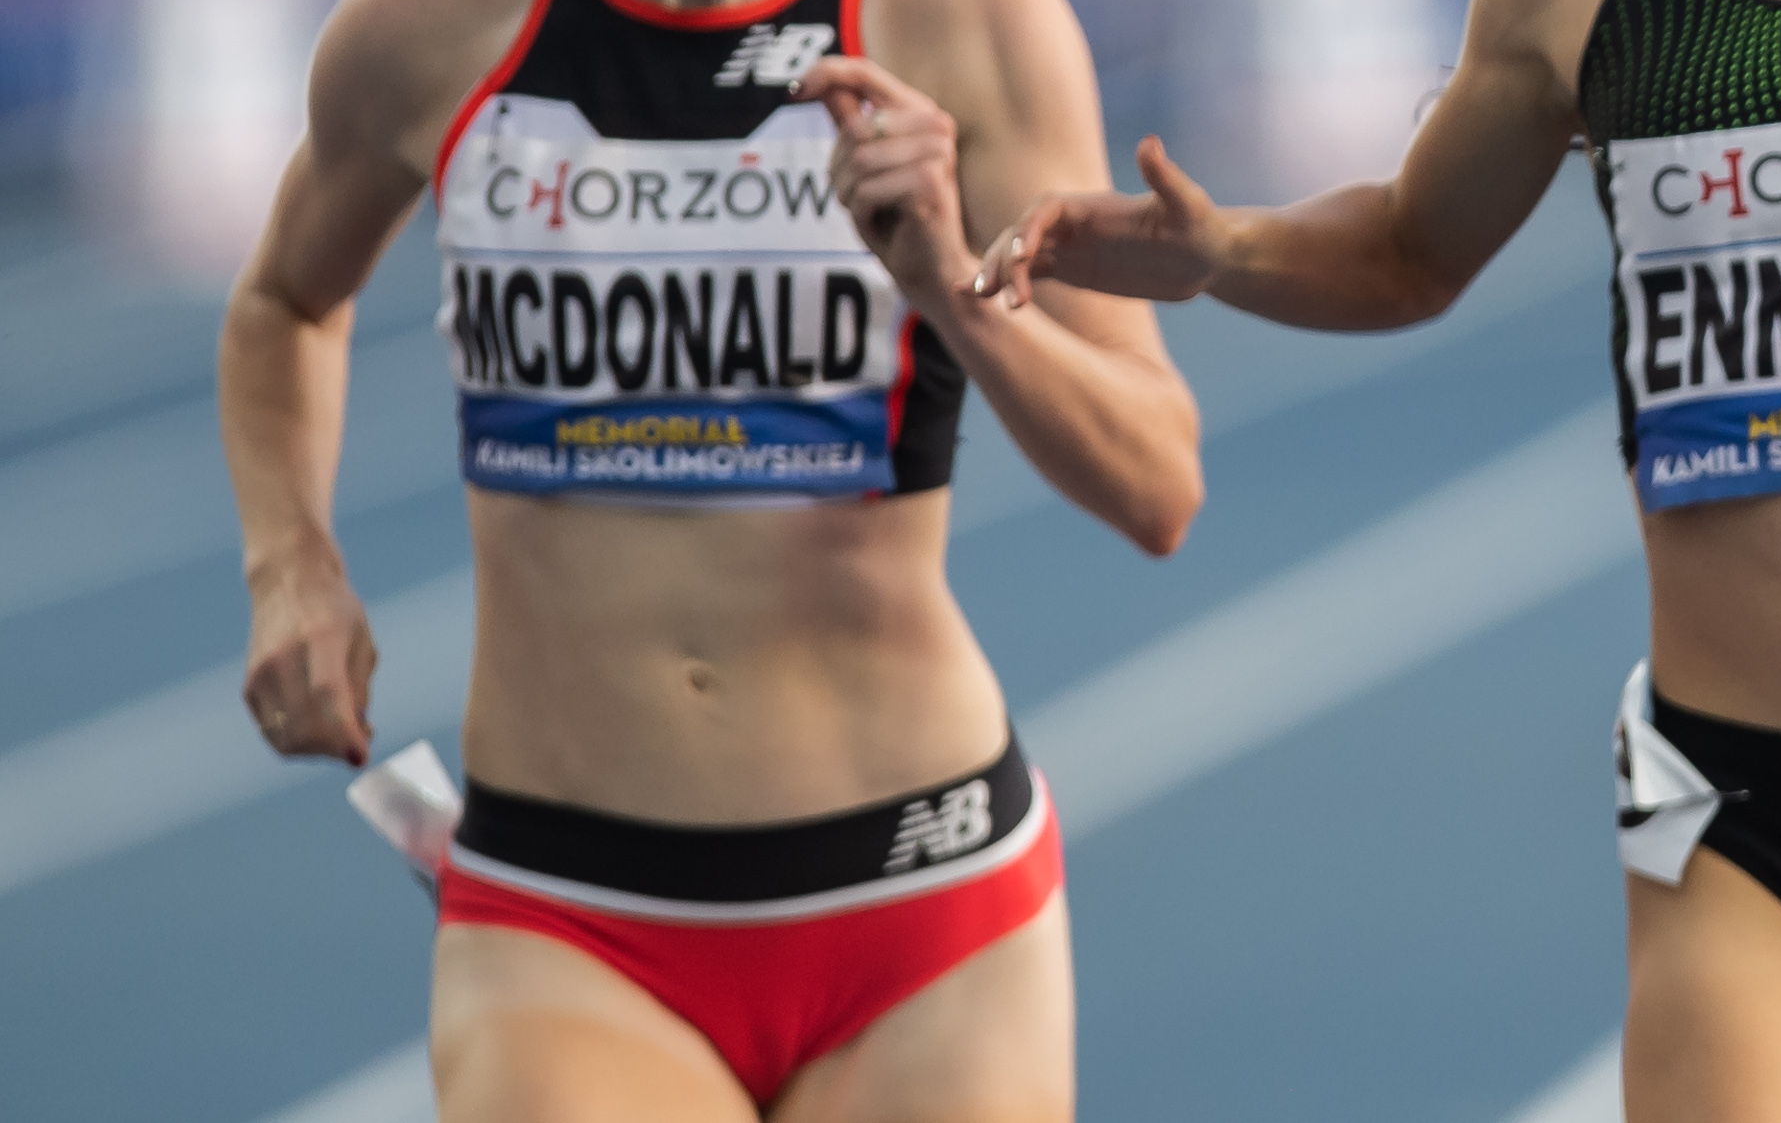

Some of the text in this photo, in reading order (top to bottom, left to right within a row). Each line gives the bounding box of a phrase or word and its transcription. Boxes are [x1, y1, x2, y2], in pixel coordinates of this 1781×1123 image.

[452, 265, 870, 391] MCDONALD
[475, 437, 864, 478] KAMILI SKOLIMOWSKIEJ
[1652, 441, 1758, 486] KAMILI
